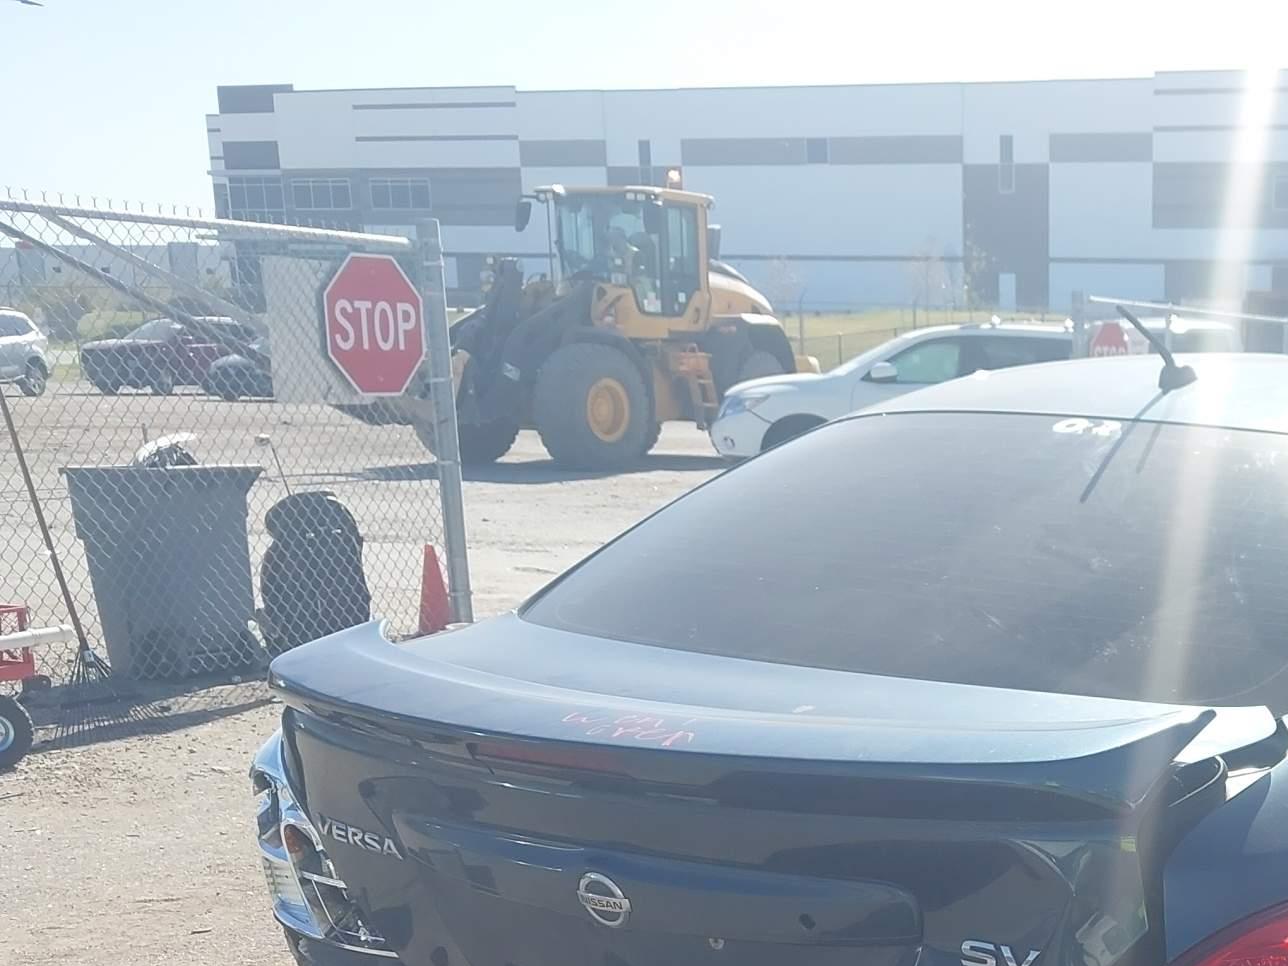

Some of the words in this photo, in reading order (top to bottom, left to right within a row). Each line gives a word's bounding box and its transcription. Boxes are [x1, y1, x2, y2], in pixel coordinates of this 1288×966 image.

[335, 299, 416, 351] STOP
[318, 817, 403, 860] VERSA
[581, 893, 623, 910] NISSAN
